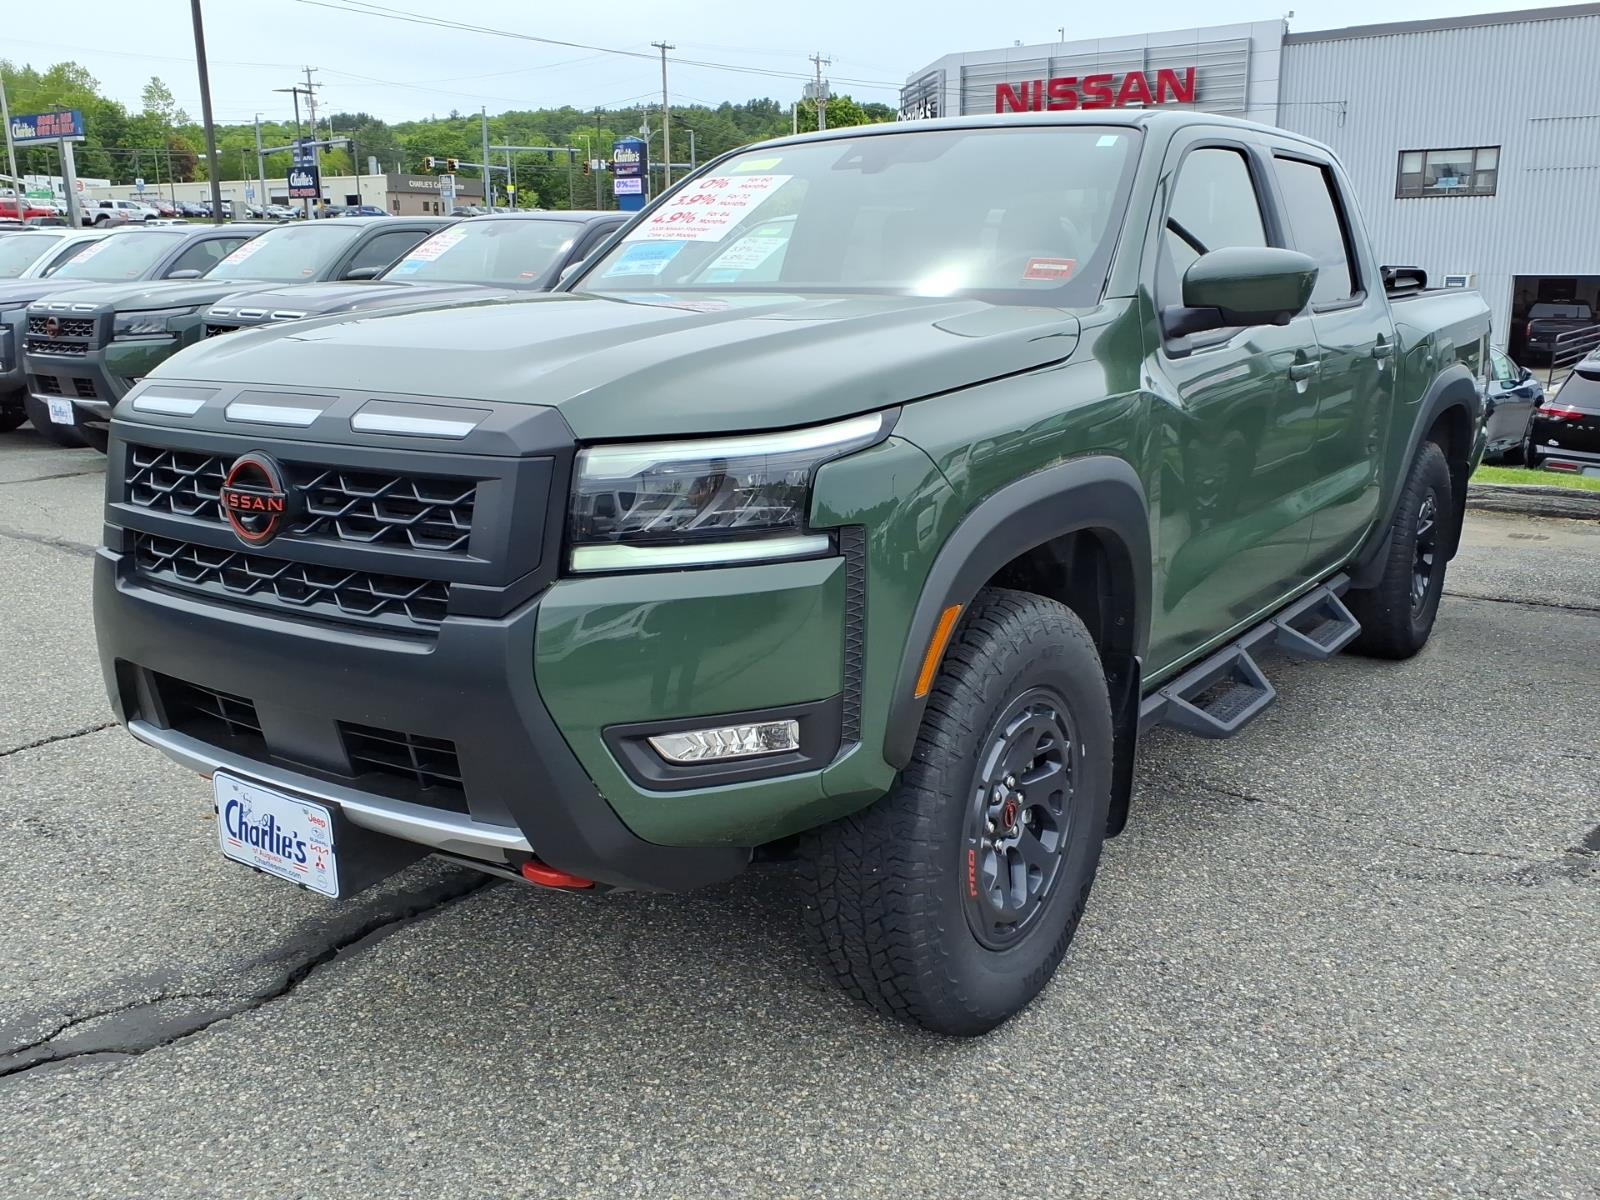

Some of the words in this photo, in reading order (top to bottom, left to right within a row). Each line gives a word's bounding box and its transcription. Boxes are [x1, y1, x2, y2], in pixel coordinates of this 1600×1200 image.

[995, 67, 1196, 114] NISSAN
[12, 121, 36, 138] Charlie's
[614, 148, 640, 163] Charlie's
[290, 172, 314, 186] Charlie's
[699, 177, 730, 189] 0%
[671, 193, 718, 206] 3.9%
[651, 211, 698, 224] 4.9%
[308, 813, 327, 829] Jeep
[225, 799, 308, 864] Charlie's
